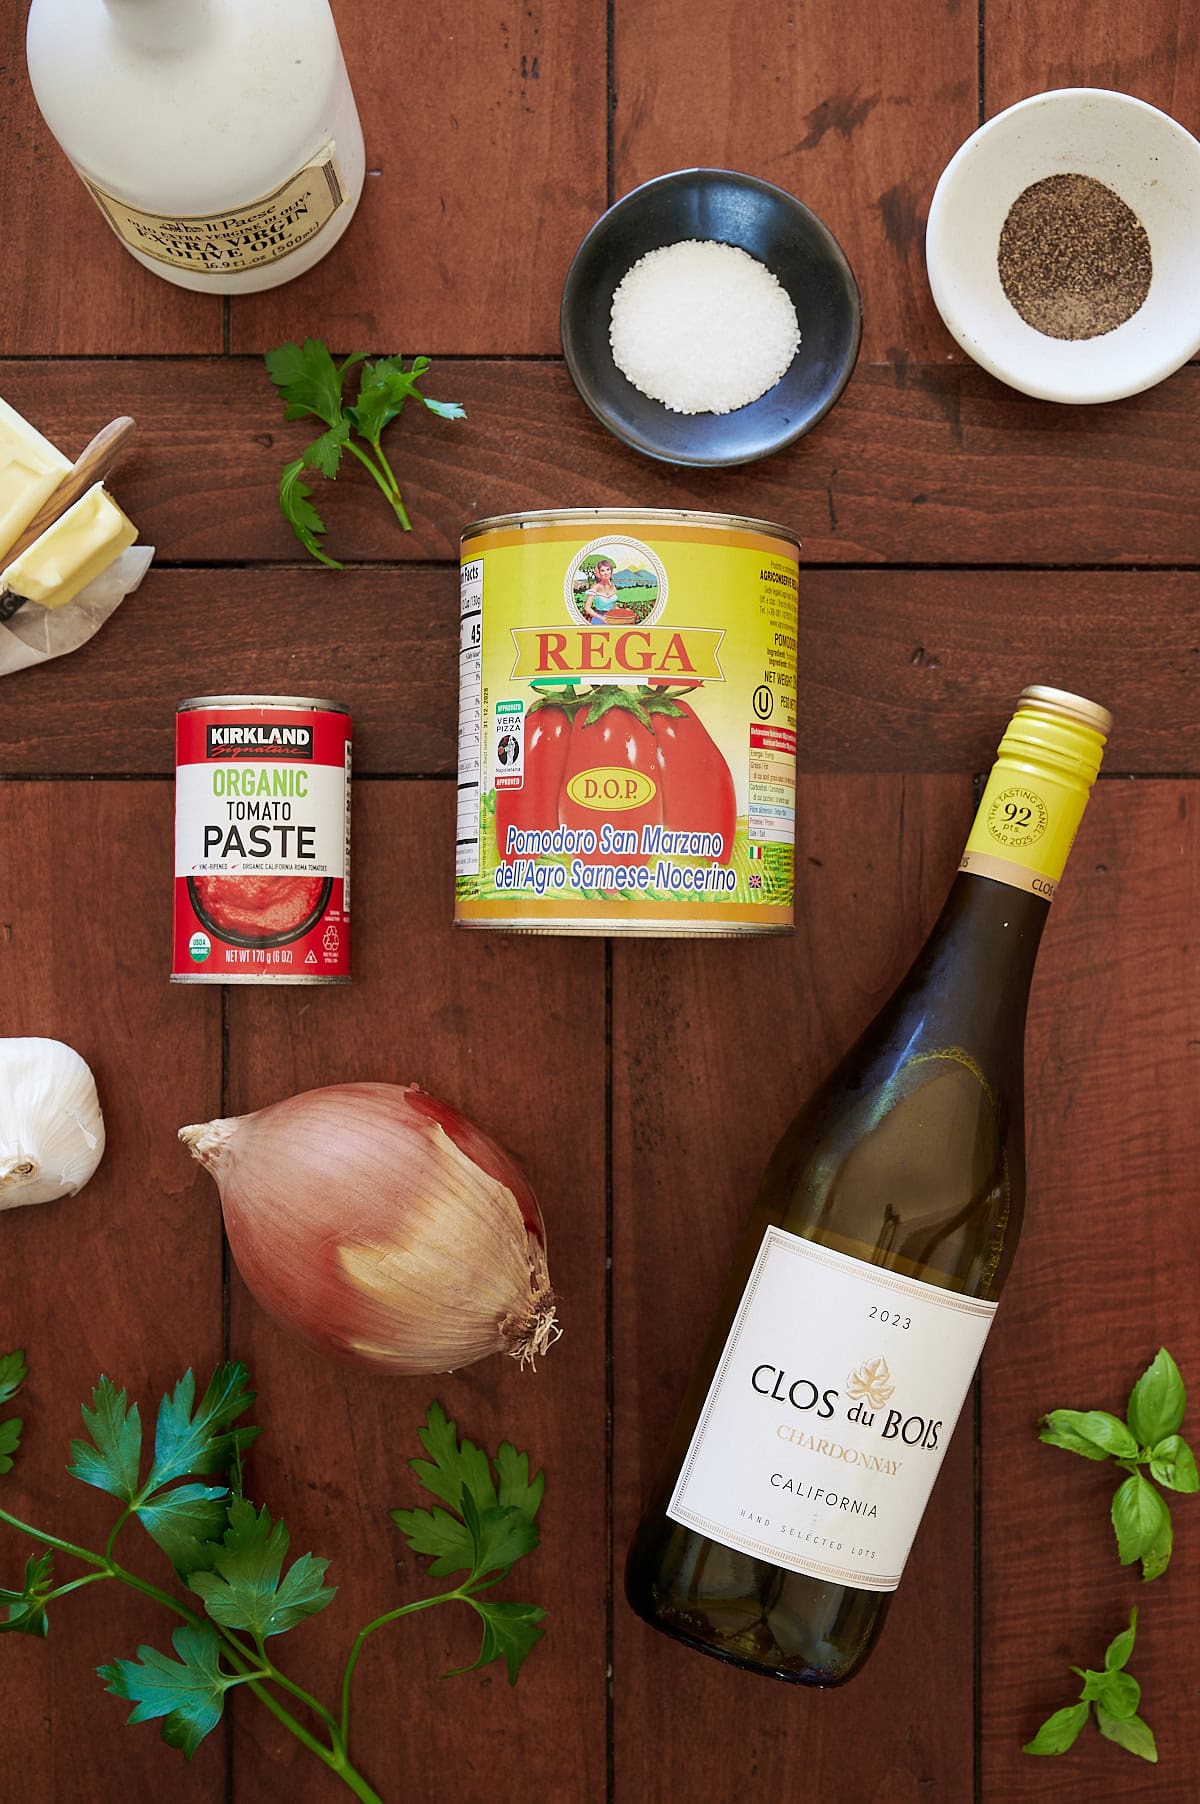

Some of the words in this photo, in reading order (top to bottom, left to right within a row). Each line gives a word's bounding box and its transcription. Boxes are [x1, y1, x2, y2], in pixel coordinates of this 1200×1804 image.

[205, 222, 262, 240] VERGINE
[264, 215, 277, 225] DI
[280, 191, 312, 216] OLIVA
[222, 205, 276, 231] Paese
[136, 228, 220, 252] EXTRA
[226, 203, 308, 247] VIRGIN
[166, 246, 243, 262] OLIVE
[250, 231, 293, 252] OIL
[204, 261, 231, 270] 16.9
[464, 565, 479, 584] Facts
[471, 623, 481, 644] 45
[535, 631, 697, 673] REGA
[764, 670, 776, 683] NET
[496, 724, 521, 733] PIZZA
[497, 716, 521, 725] VERA
[211, 727, 310, 745] KIRKLAND
[211, 744, 308, 758] Signature
[212, 768, 308, 798] ORGANIC
[496, 777, 520, 786] APPROVED
[583, 778, 638, 800] D.O.P.
[226, 801, 291, 821] TOMATO
[989, 803, 1000, 821] THE
[999, 789, 1038, 805] TASTING
[1033, 803, 1047, 834] PANEL
[1001, 803, 1032, 828] 92
[991, 825, 1008, 843] MAR
[1009, 835, 1034, 845] 2025
[1002, 822, 1021, 834] pts.
[203, 825, 316, 859] PASTE
[506, 826, 594, 855] Pomodoro
[600, 825, 638, 854] San
[641, 826, 723, 856] Marzano
[294, 864, 307, 872] ROMA
[495, 861, 566, 894] dell'Agro
[570, 861, 737, 892] Sarnese-Nocerino
[1031, 878, 1054, 897] CLOS
[192, 938, 206, 946] USDA
[225, 949, 239, 963] NET
[239, 950, 250, 963] WT
[252, 950, 265, 963] 170
[266, 953, 271, 965] g
[272, 950, 280, 964] (6
[281, 950, 293, 964] OZ)
[868, 1306, 912, 1330] 2023
[751, 1364, 839, 1419] CLOS
[846, 1402, 875, 1427] du
[881, 1409, 943, 1451] BOIS
[776, 1424, 903, 1477] CHARDONNAY
[770, 1473, 878, 1519] CALIFORNIA
[739, 1509, 771, 1527] HAND
[780, 1525, 843, 1551] SELECTED
[851, 1546, 877, 1559] LOTS
